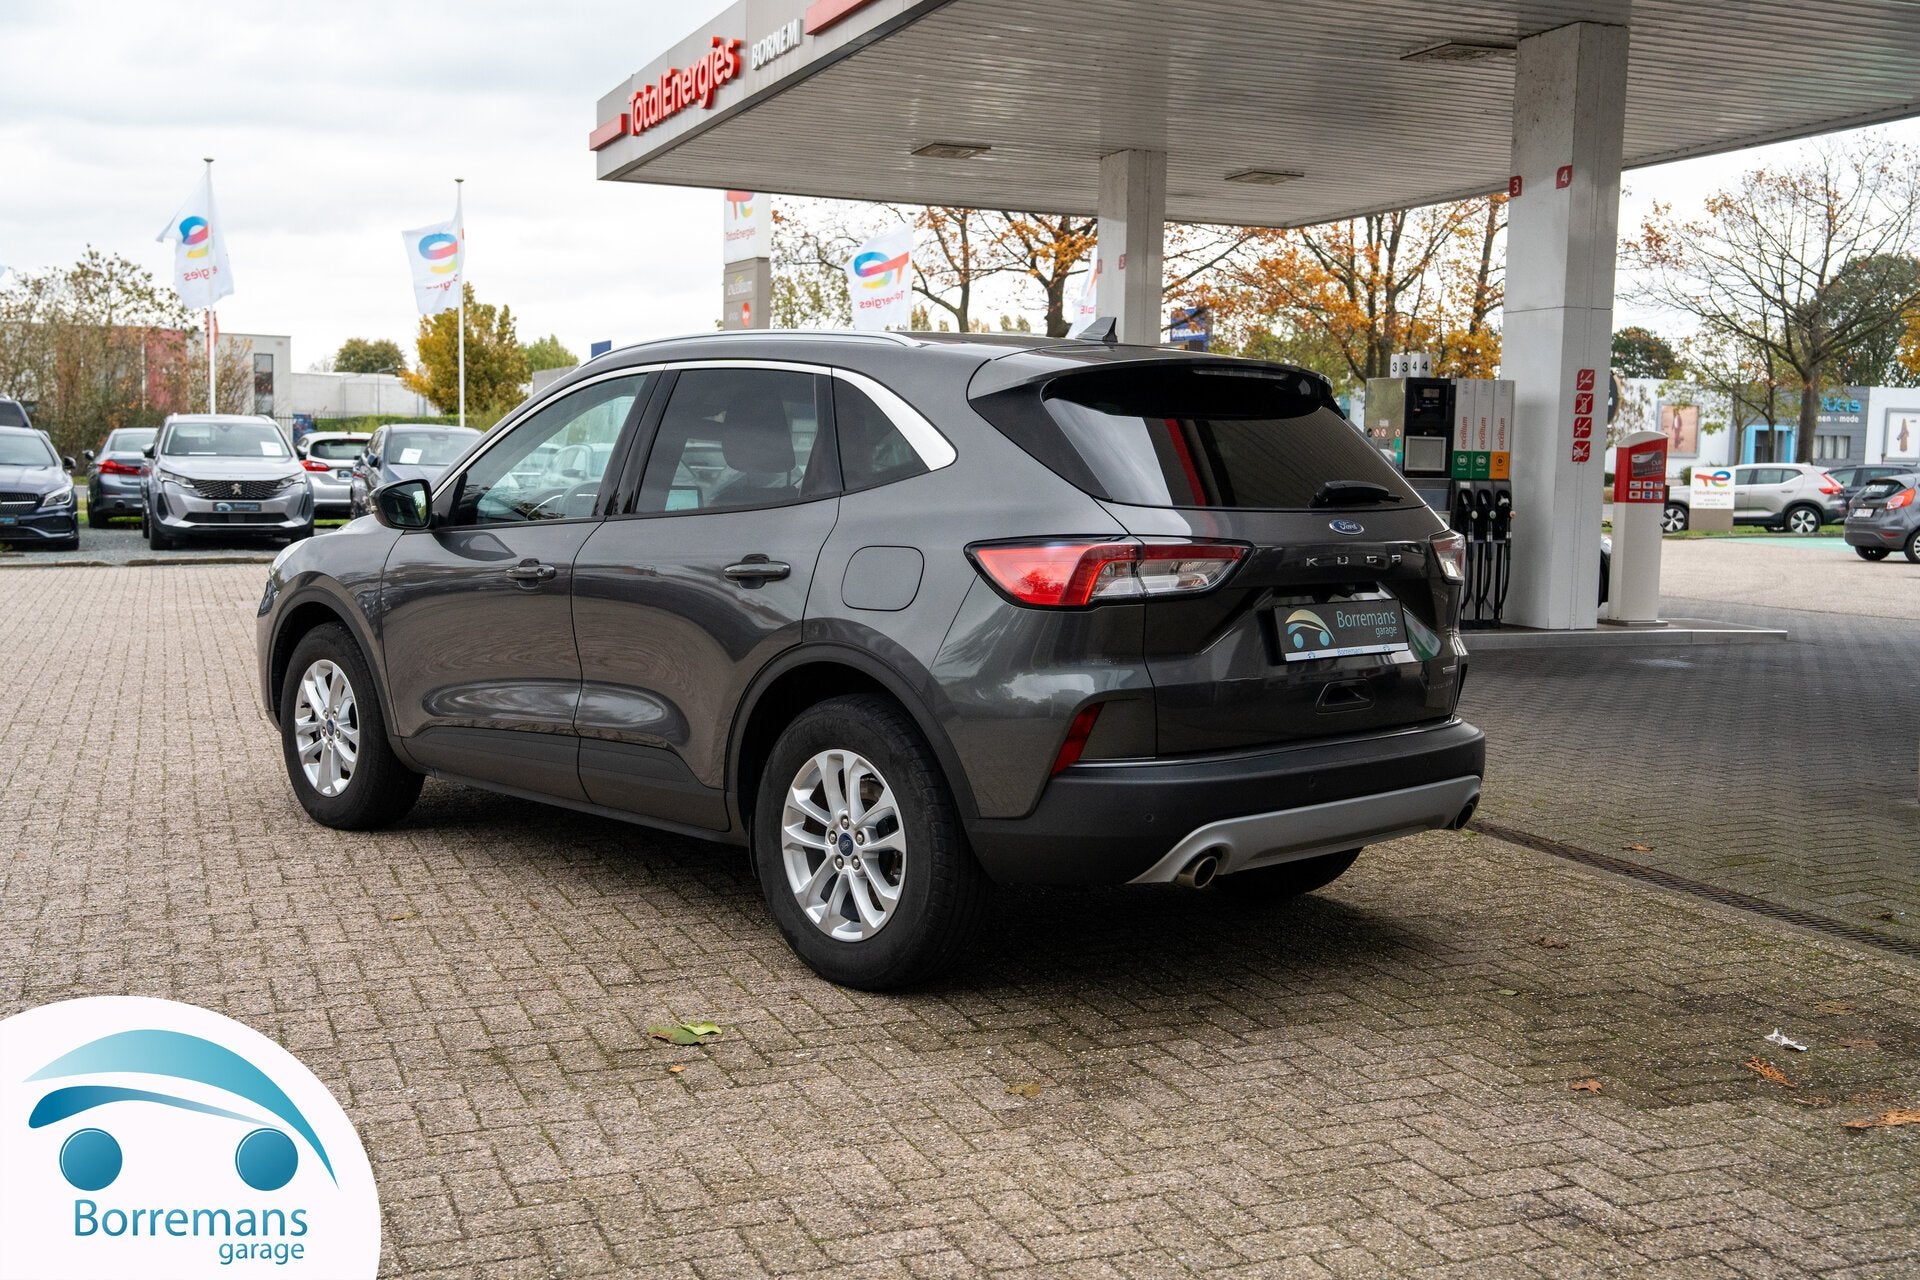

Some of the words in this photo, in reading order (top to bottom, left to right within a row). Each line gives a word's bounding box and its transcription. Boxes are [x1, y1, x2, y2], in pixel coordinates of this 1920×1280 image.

[628, 36, 741, 136] TotalEnergies
[752, 20, 801, 71] BORNEM
[1561, 170, 1568, 184] 4
[1513, 180, 1519, 194] 3
[1401, 361, 1409, 373] 3
[1421, 360, 1429, 372] 4
[1839, 415, 1859, 424] mode
[1338, 521, 1358, 530] Ford
[1306, 554, 1402, 567] KUGA
[1336, 610, 1397, 629] Borremans
[1375, 626, 1398, 638] garage
[1336, 647, 1364, 656] Borremans
